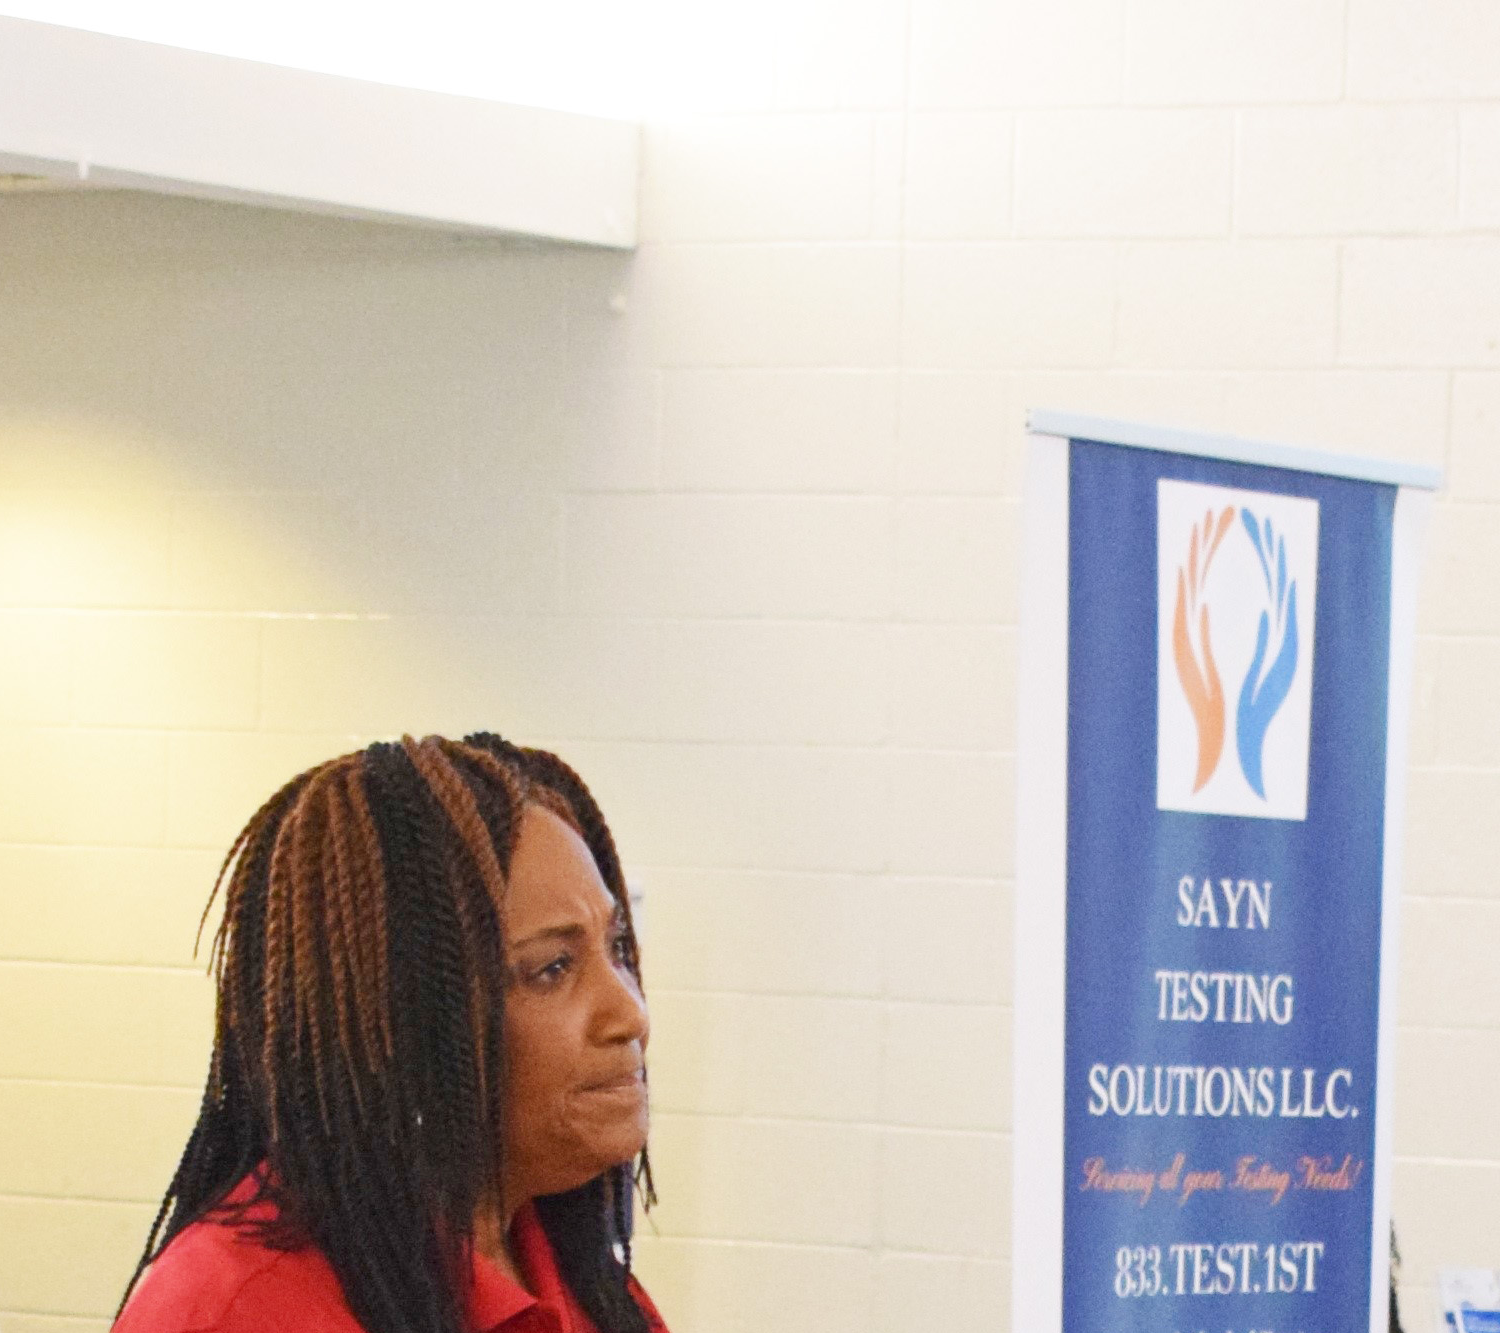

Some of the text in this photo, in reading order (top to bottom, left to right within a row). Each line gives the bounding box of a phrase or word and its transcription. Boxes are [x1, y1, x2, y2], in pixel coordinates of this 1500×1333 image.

[1178, 875, 1272, 929] SAYN
[1156, 970, 1294, 1025] TESTING
[1088, 1063, 1360, 1119] SOLUTIONS LLC.
[1230, 1155, 1290, 1206] Testing
[1113, 1242, 1325, 1298] 833.TEST.1ST
